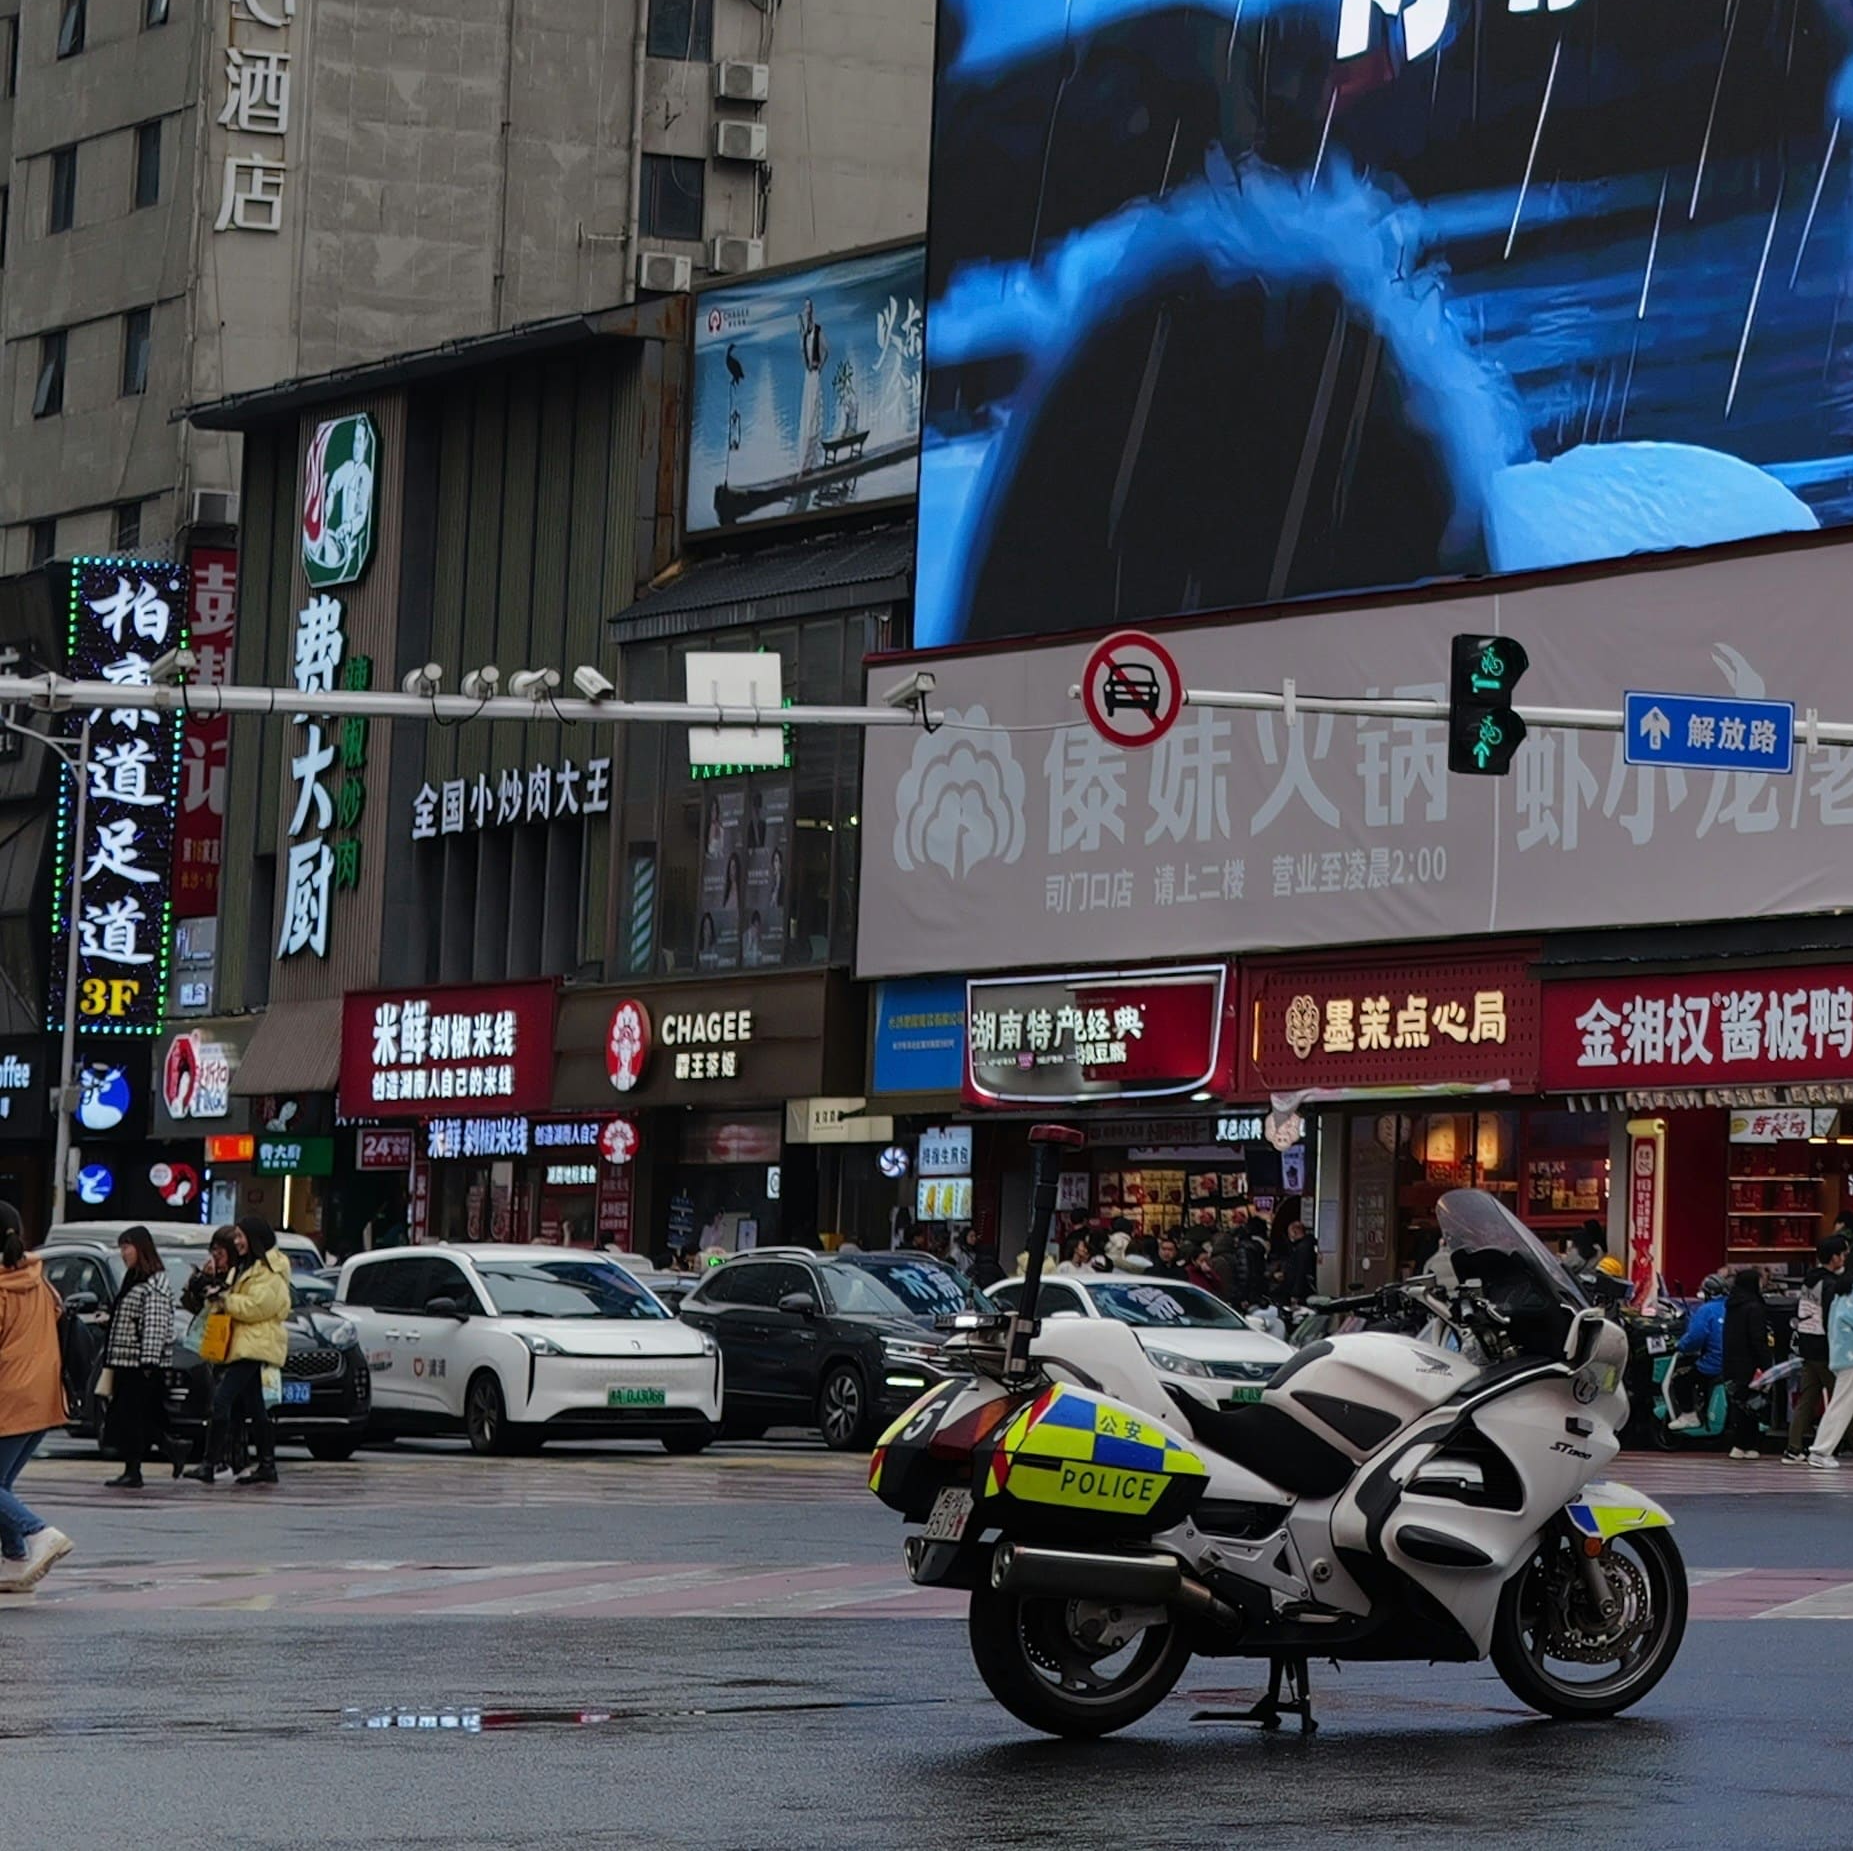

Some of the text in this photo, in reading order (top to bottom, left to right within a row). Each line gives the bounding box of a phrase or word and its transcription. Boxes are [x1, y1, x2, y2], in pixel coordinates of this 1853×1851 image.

[1686, 713, 1778, 755] 解放路
[276, 593, 345, 958] 费大厨
[411, 757, 611, 841] 全国小炒肉大王
[1045, 846, 1447, 915] 司门口店 请上二楼 营业至凌晨2:00
[79, 978, 140, 1016] 3F
[660, 1009, 752, 1046] CHAGEE
[1323, 989, 1507, 1054] 墨茉点心局
[371, 1064, 516, 1102] 创造湖南人自己的米线
[674, 1051, 738, 1080] 霸王茶姬
[903, 1400, 948, 1442] 5
[1099, 1414, 1142, 1441] 公安
[1060, 1468, 1155, 1502] POLICE
